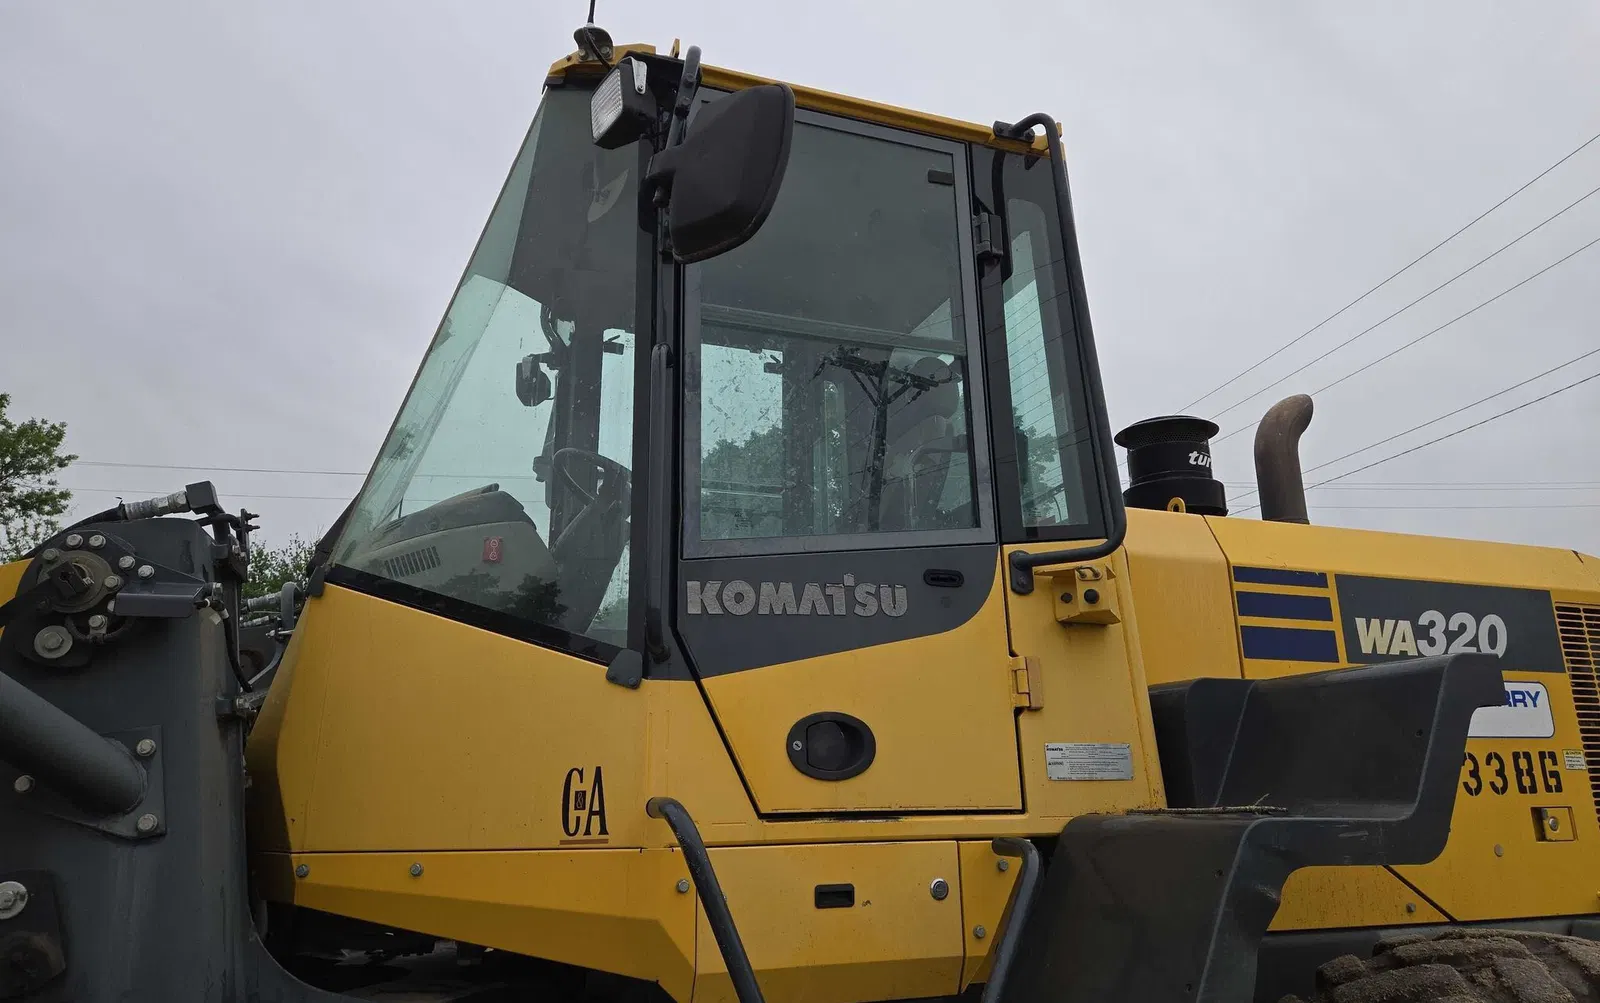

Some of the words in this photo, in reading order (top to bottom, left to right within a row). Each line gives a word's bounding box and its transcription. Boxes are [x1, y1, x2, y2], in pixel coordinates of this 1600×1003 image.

[686, 572, 908, 617] KOMATSU
[1355, 609, 1507, 659] WA320
[561, 765, 609, 837] C&A
